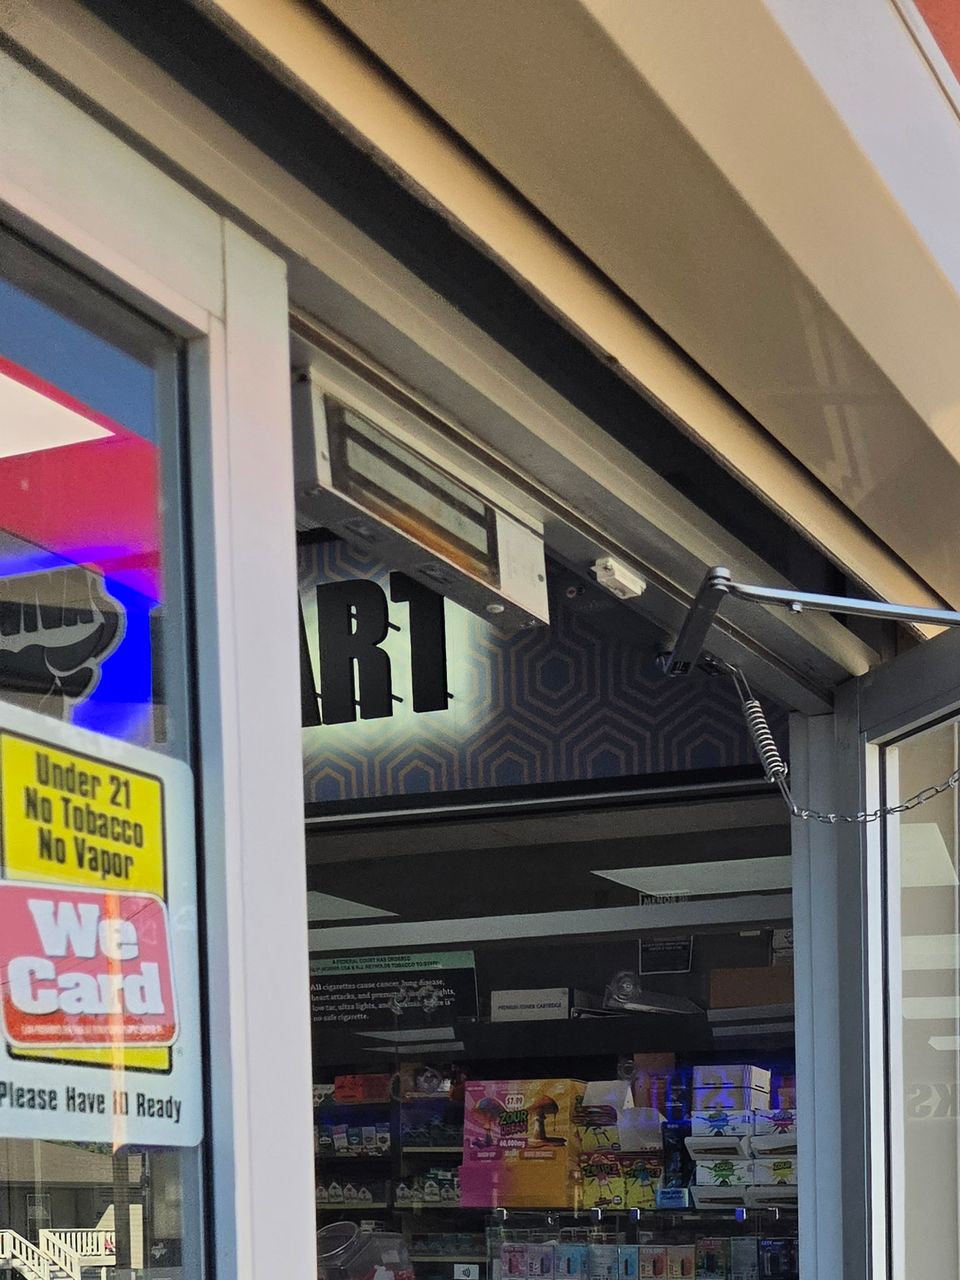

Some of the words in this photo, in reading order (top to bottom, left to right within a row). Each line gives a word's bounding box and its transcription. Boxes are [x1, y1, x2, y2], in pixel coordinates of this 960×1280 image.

[36, 751, 101, 800] Under
[109, 774, 130, 810] 21
[25, 786, 52, 824] No
[61, 797, 144, 848] Tobacco
[38, 827, 66, 864] No
[74, 836, 134, 880] Vapor
[28, 899, 139, 960] We
[8, 956, 165, 1015] Card
[0, 1080, 58, 1111] Please
[67, 1085, 105, 1114] Have
[137, 1091, 182, 1123] Ready
